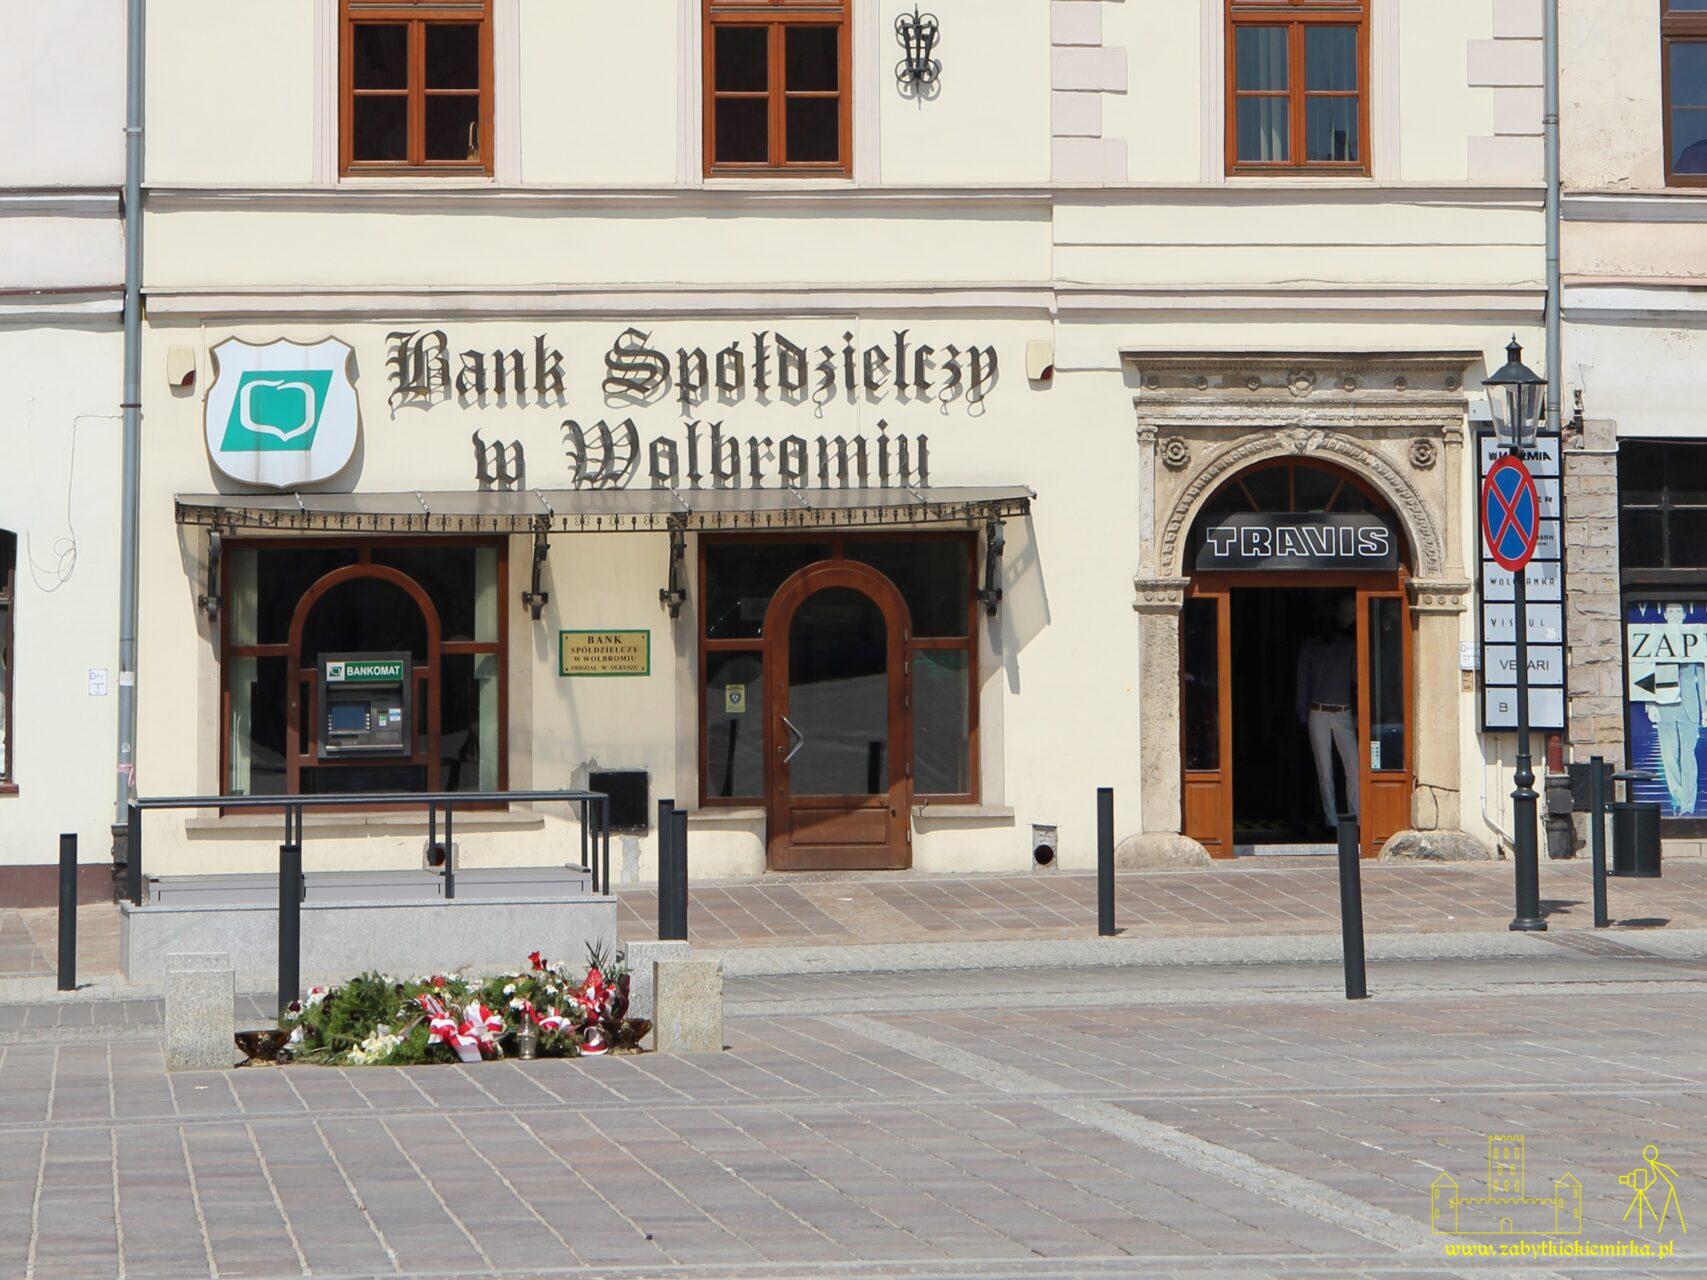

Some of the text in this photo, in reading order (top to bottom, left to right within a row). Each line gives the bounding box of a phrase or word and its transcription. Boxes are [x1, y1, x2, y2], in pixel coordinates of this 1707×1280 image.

[384, 326, 999, 410] Bank Spółdzielczy
[471, 417, 931, 490] w Wolbromiu
[1206, 526, 1390, 557] TRAVIS
[1490, 577, 1555, 586] WOLANKA
[1490, 618, 1545, 627] VISUL
[587, 635, 622, 644] BANK
[1631, 632, 1707, 658] ZAP
[346, 665, 401, 677] BANKOMAT
[1499, 660, 1550, 671] VEARI
